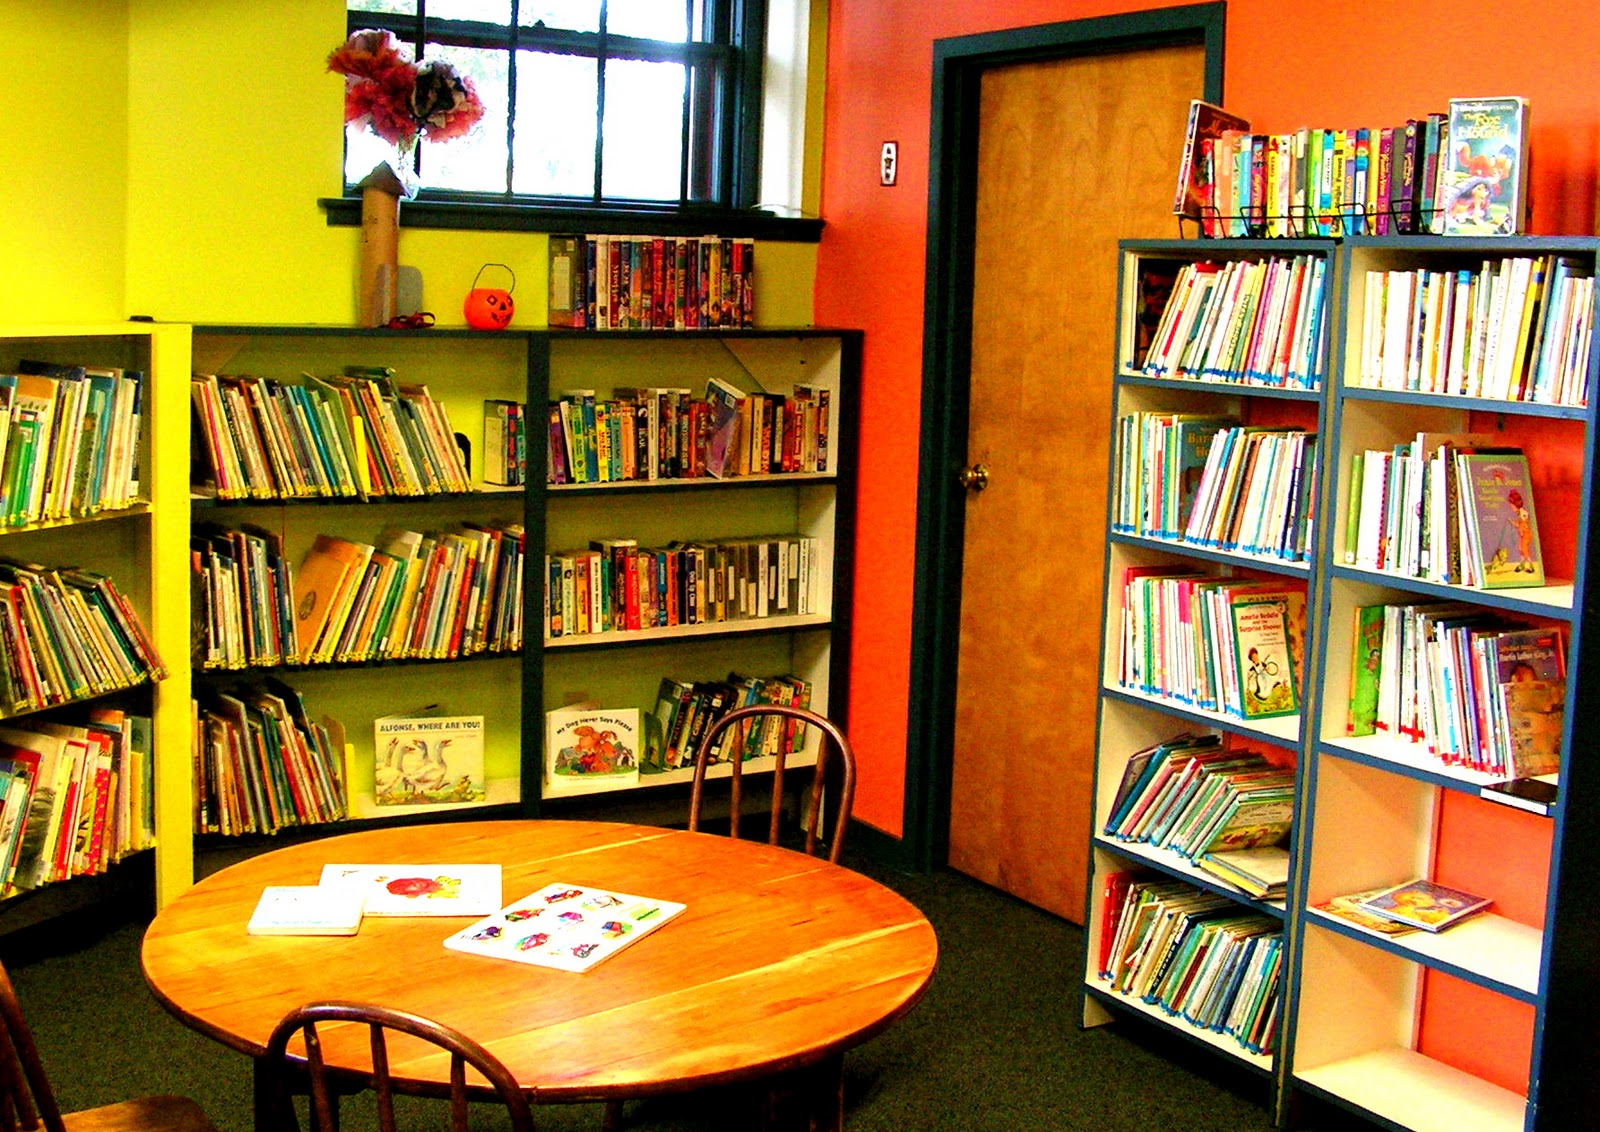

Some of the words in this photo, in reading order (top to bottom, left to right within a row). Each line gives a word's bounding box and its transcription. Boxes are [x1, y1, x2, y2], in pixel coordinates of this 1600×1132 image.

[417, 722, 443, 730] WHERE
[445, 721, 460, 729] ARE
[565, 720, 579, 728] Dog
[614, 719, 633, 732] Please
